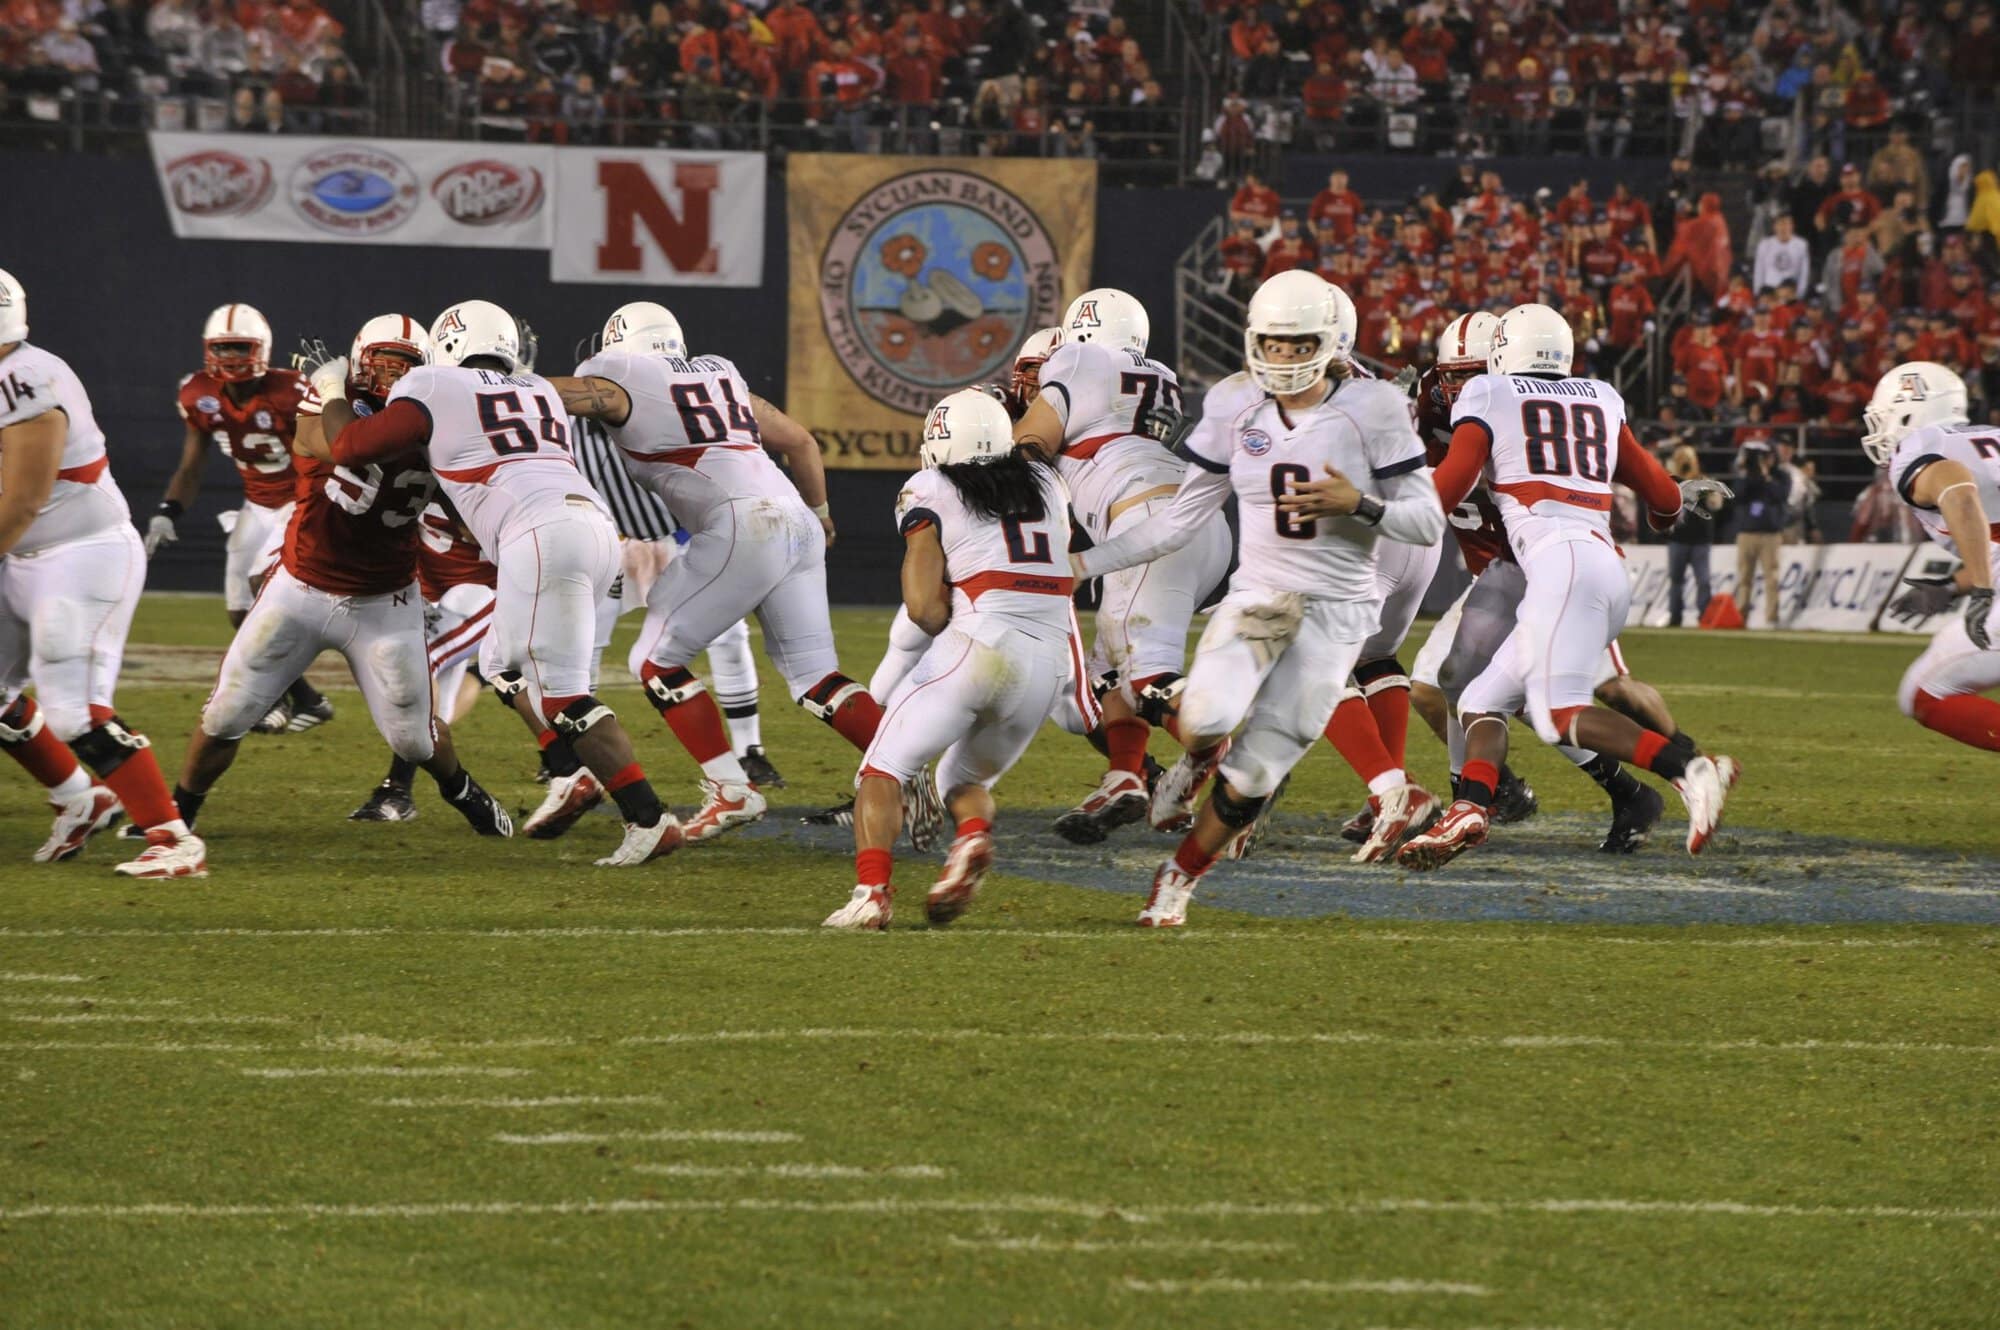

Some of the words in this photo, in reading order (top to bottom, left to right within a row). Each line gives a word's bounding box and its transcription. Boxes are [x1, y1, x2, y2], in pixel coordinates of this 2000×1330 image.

[597, 160, 720, 271] N
[847, 176, 951, 237] SYCUAN
[959, 182, 1034, 239] BAND
[670, 378, 761, 445] 64
[1512, 378, 1598, 399] SIMMONS
[212, 430, 291, 475] 13
[475, 391, 570, 456] 54
[1521, 399, 1609, 484] 88
